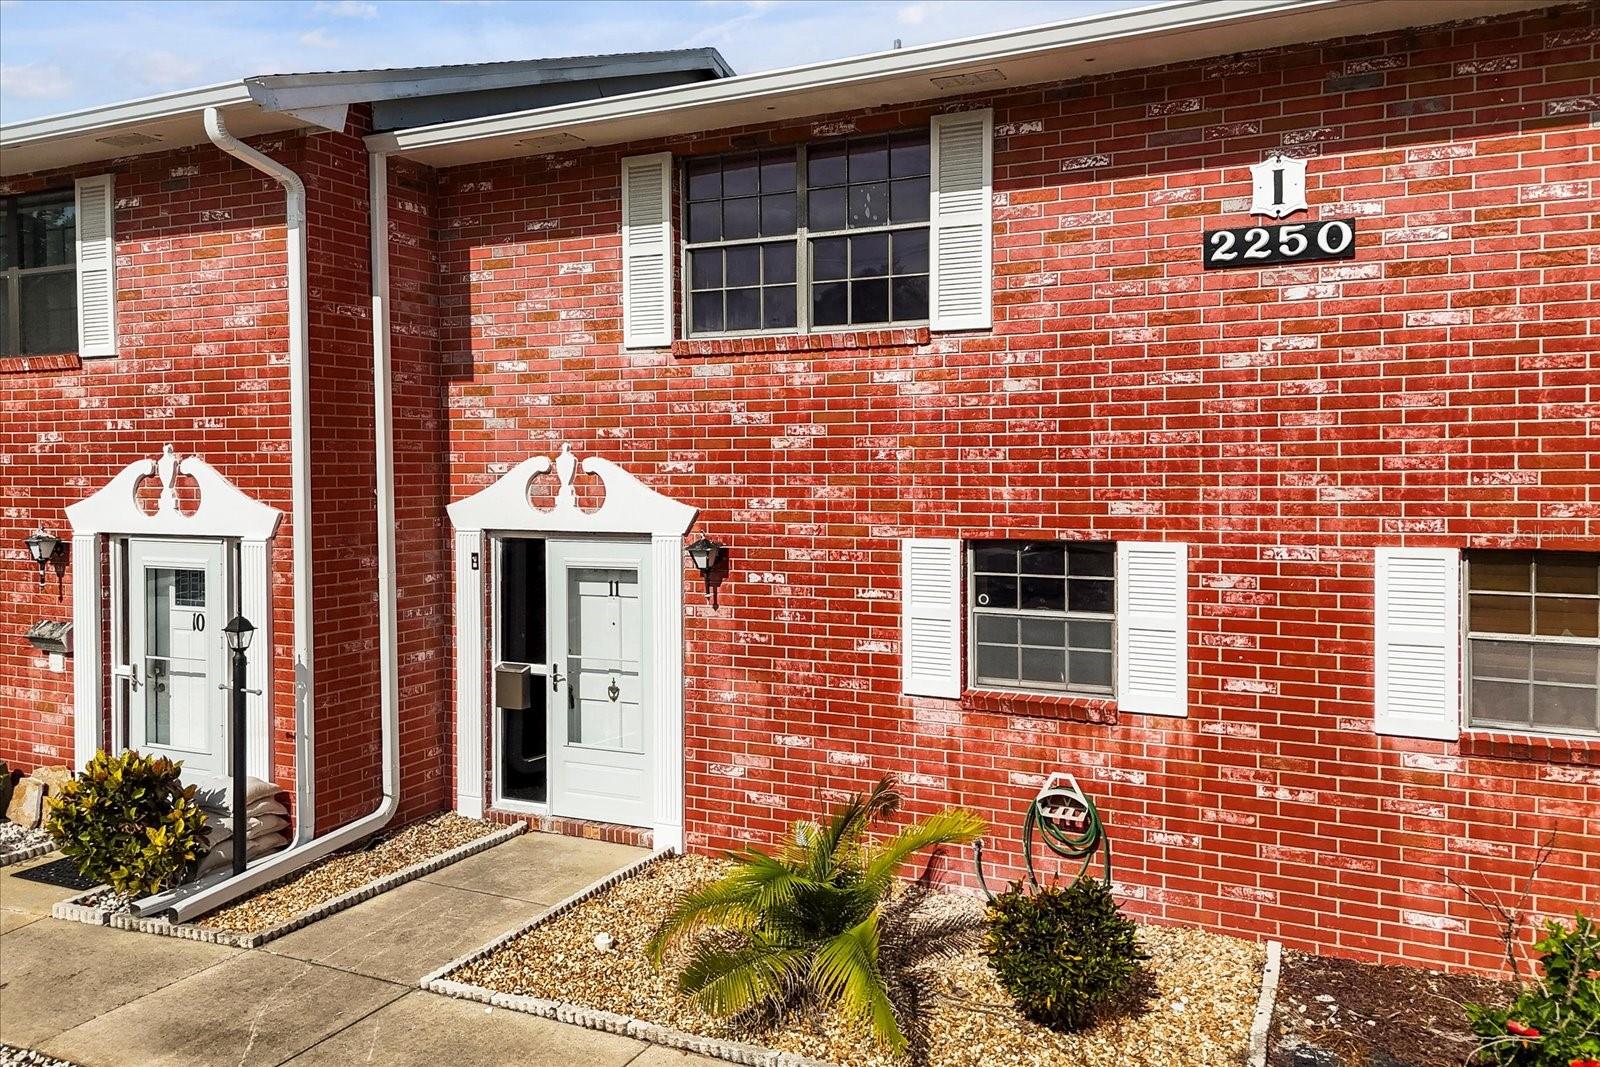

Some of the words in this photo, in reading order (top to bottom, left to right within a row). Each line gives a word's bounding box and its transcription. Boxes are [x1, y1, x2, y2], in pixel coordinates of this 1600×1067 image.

[1210, 221, 1353, 262] 2250
[608, 580, 619, 597] 11
[192, 612, 206, 632] 10
